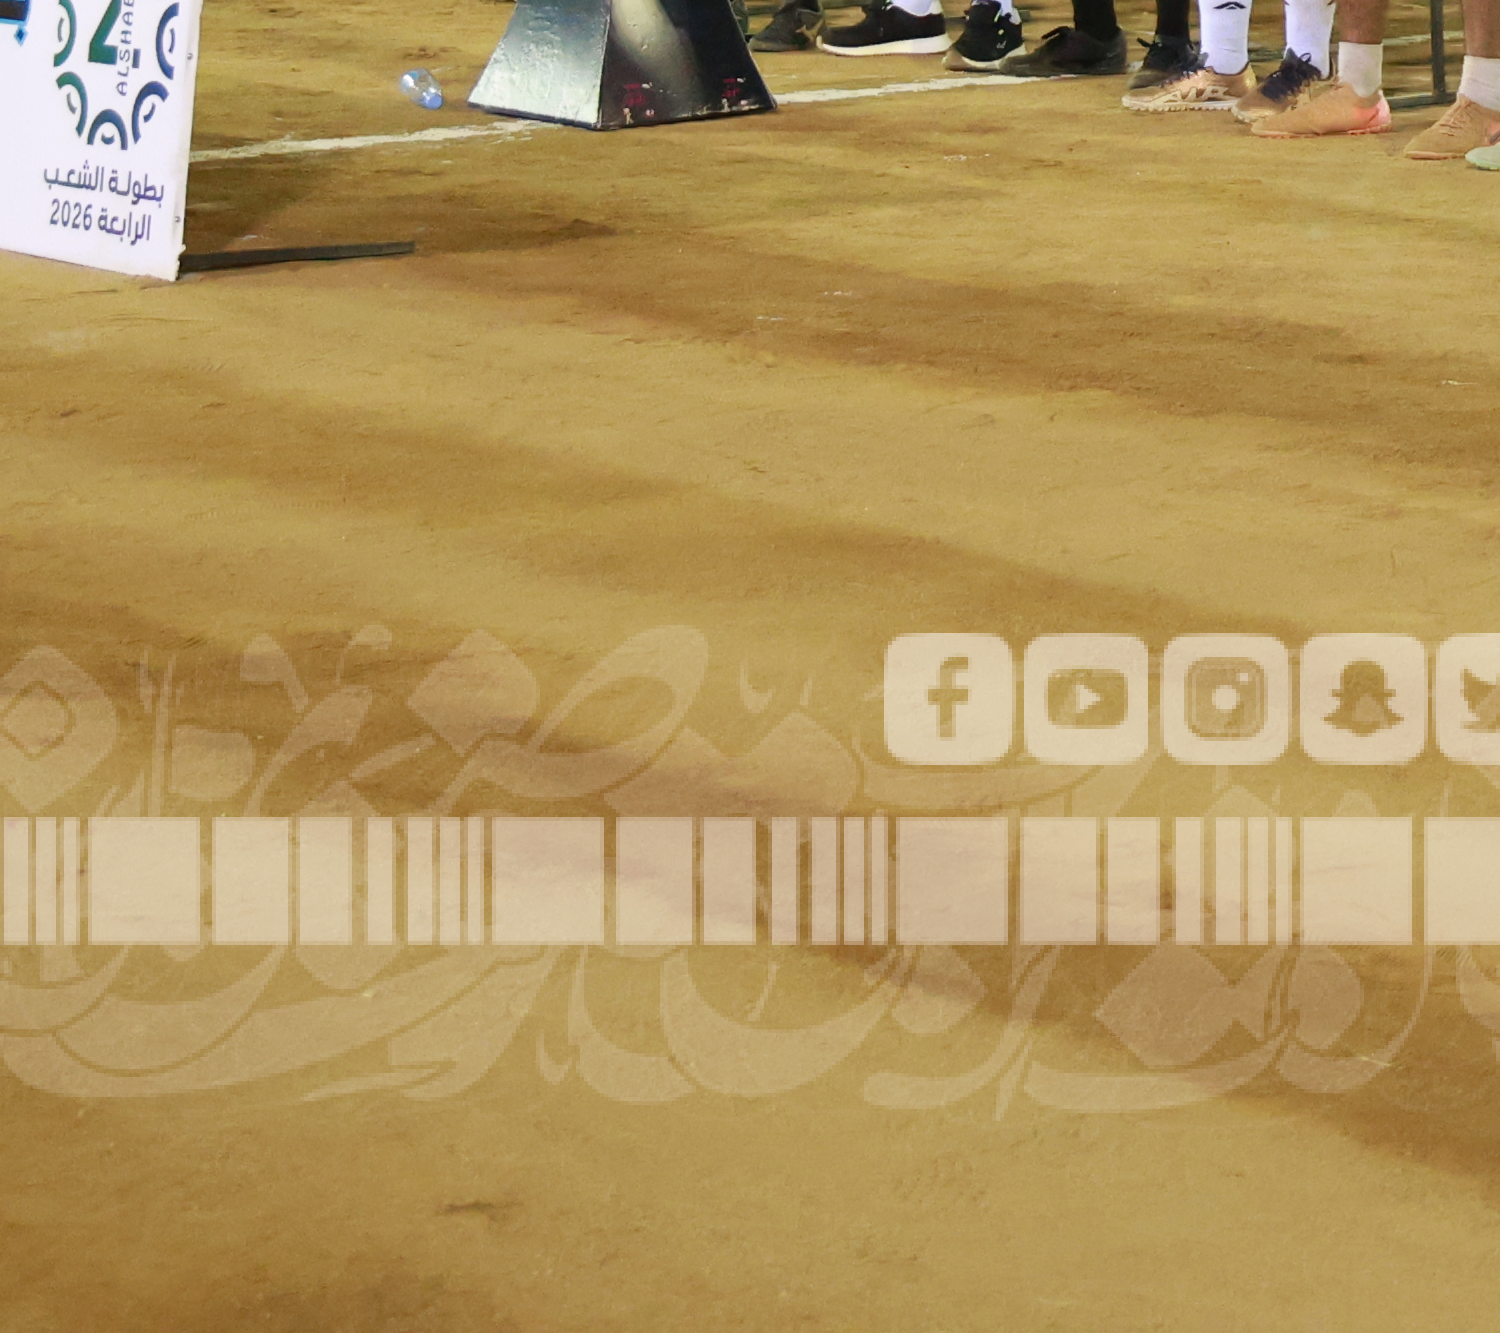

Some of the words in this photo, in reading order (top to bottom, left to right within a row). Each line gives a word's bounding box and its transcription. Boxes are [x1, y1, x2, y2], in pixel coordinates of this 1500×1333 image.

[43, 159, 105, 193] الشعب
[109, 169, 164, 208] بطولة
[50, 198, 92, 231] 2026
[98, 208, 151, 245] الرابعة
